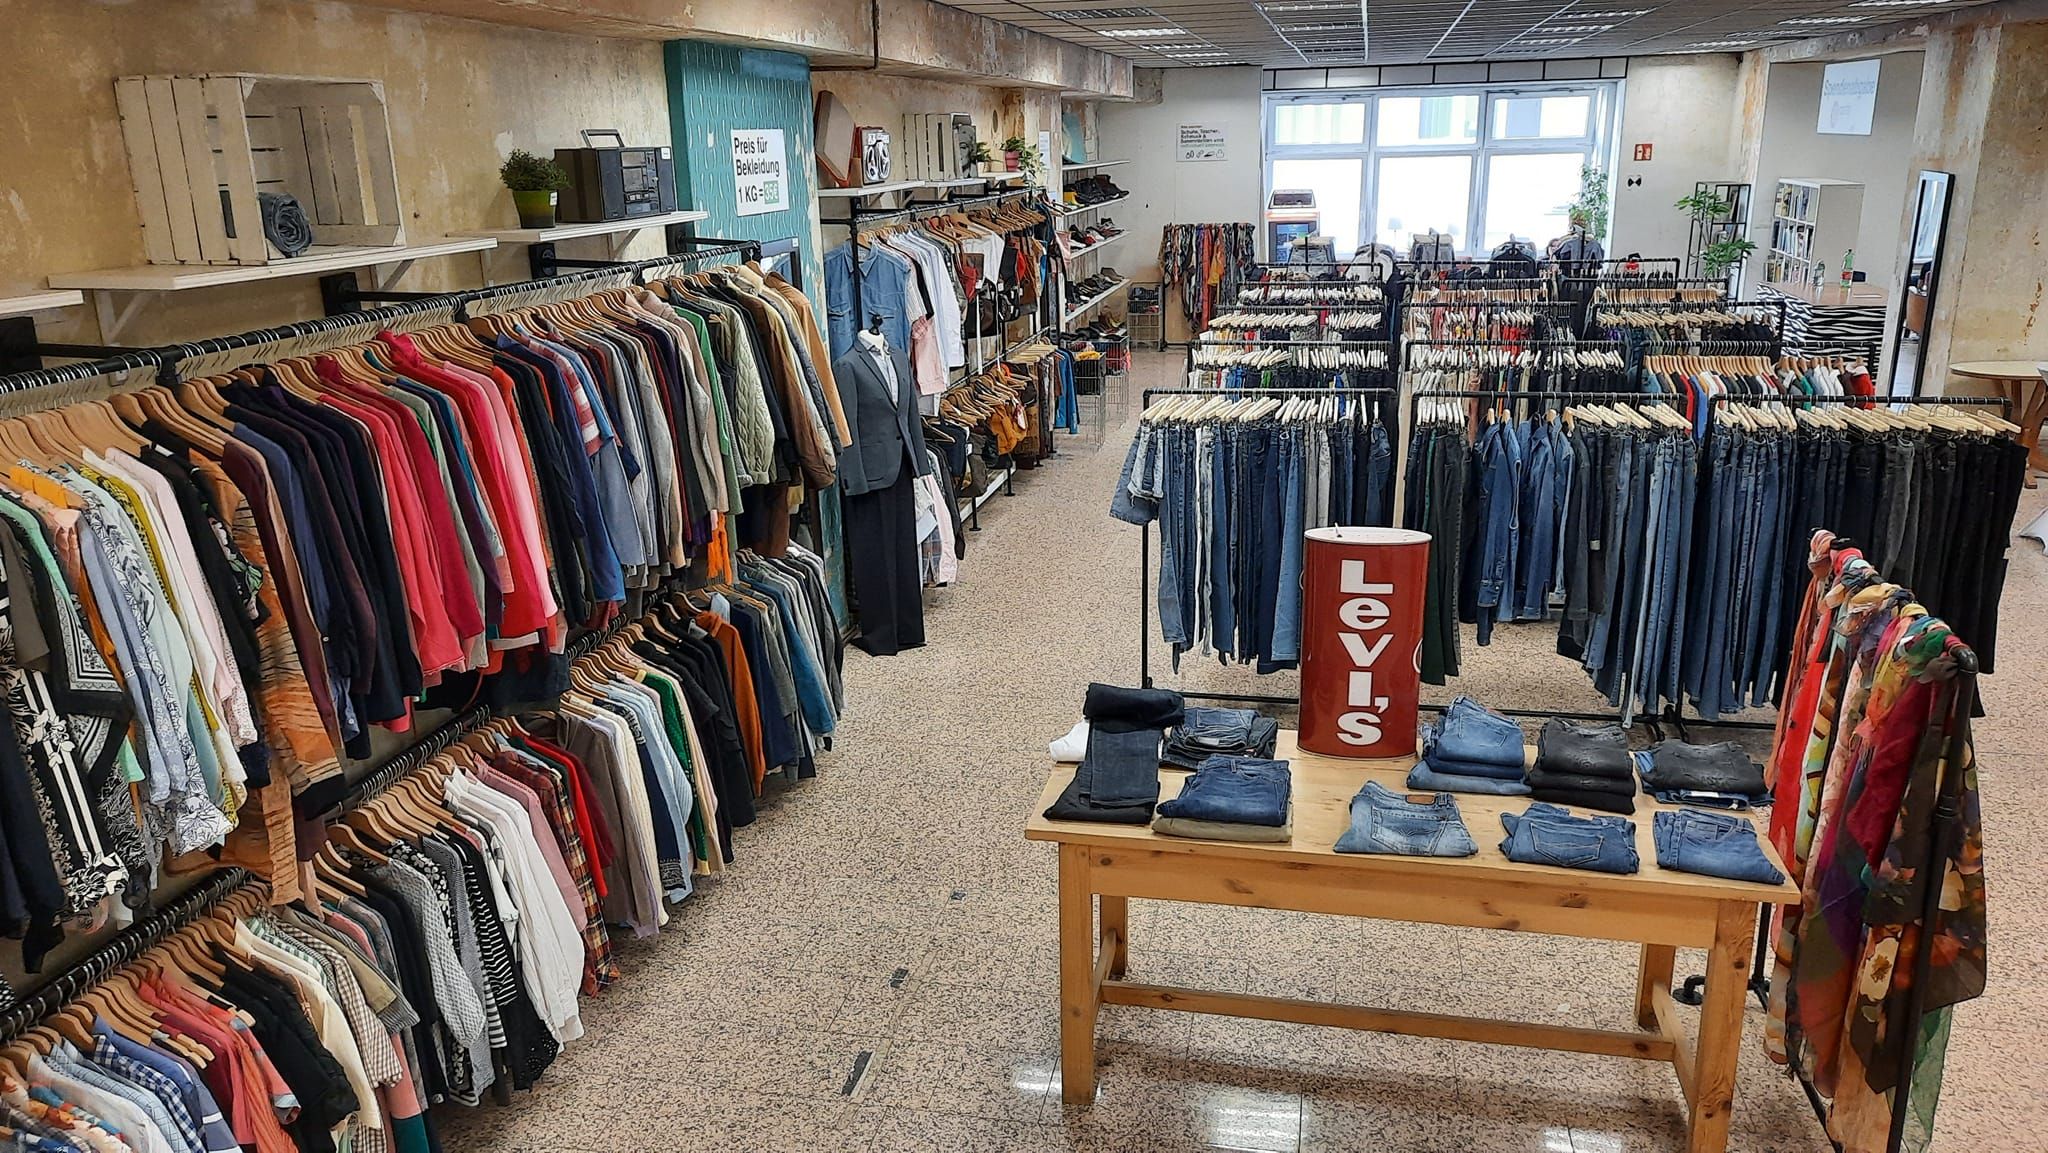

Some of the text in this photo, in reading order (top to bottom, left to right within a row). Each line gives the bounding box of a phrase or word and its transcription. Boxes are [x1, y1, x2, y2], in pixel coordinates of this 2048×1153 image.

[734, 136, 768, 154] Preis für
[736, 158, 780, 178] Bekleidung
[739, 187, 743, 203] 1
